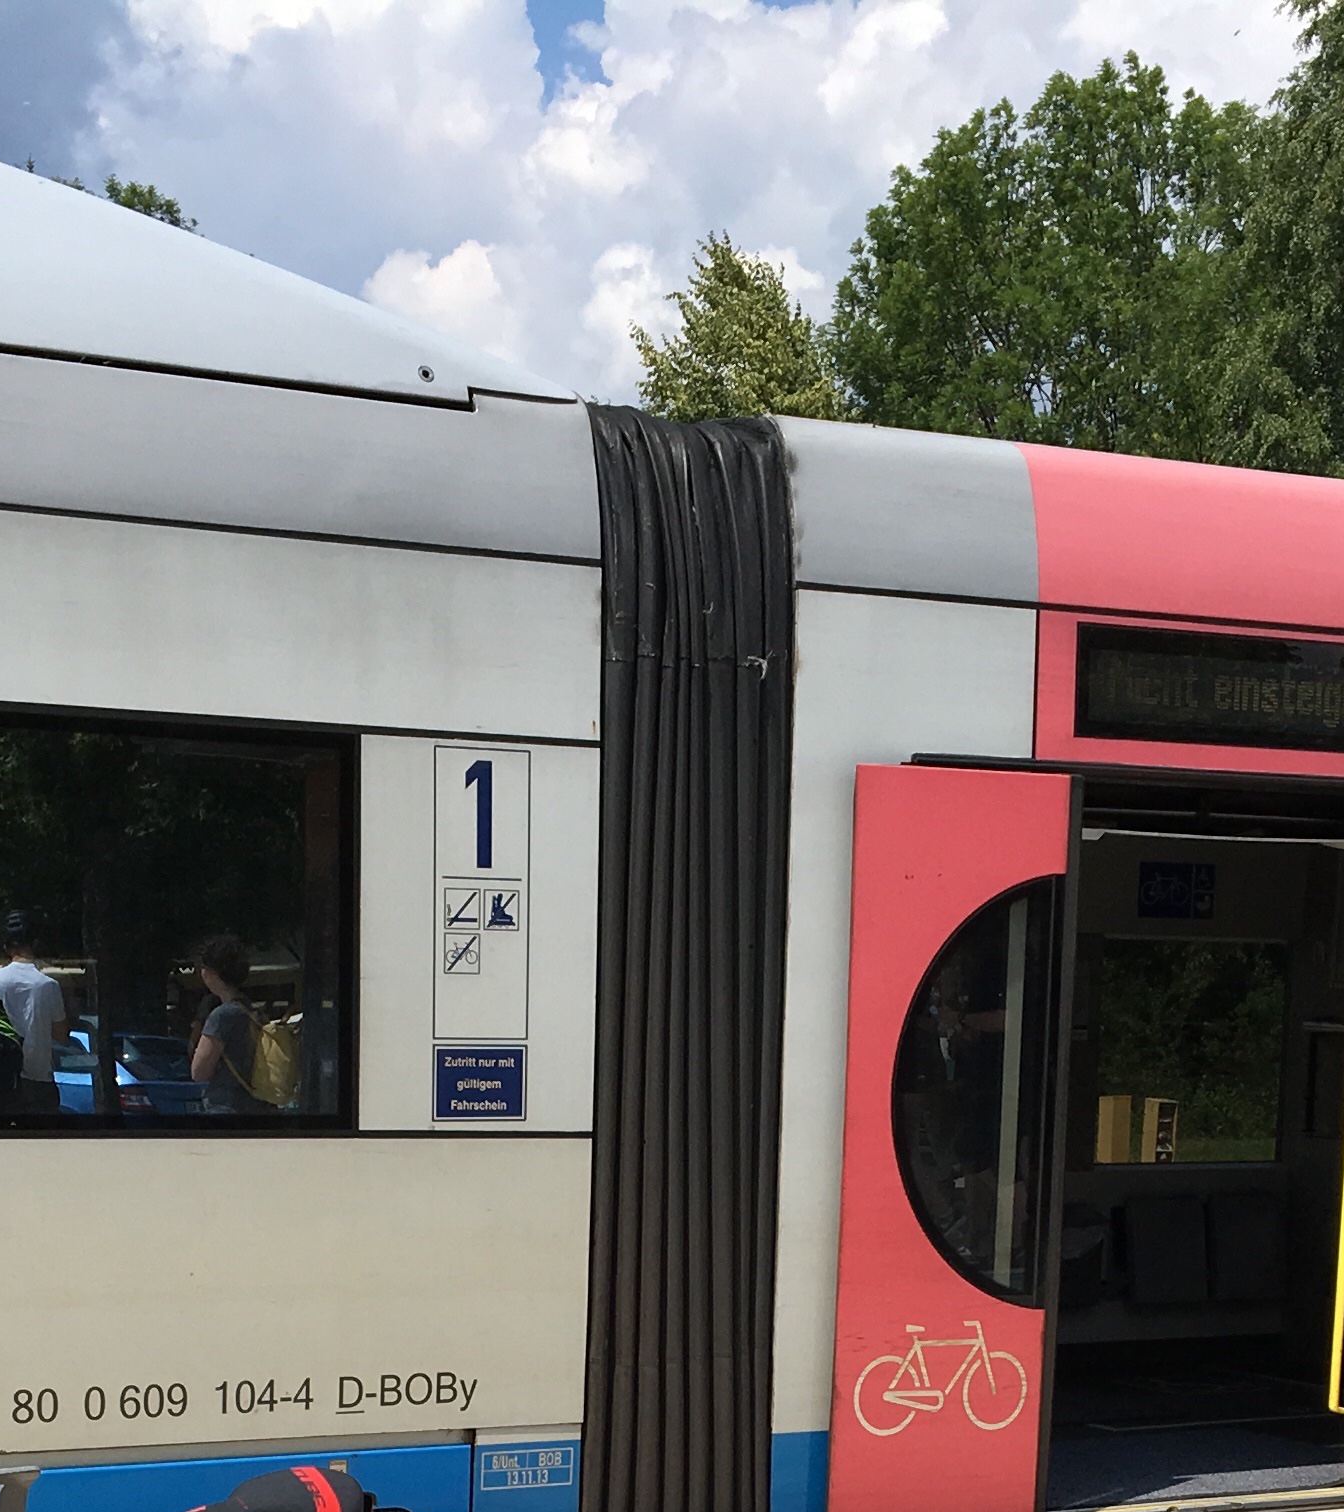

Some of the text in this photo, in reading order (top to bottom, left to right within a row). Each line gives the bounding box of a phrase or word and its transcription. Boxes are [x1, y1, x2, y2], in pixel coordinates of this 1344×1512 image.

[464, 759, 493, 869] 1
[444, 1056, 515, 1069] Zutritt nur mit
[456, 1077, 502, 1092] gültigem
[450, 1099, 508, 1112] Fahrschein
[11, 1388, 60, 1424] 80
[215, 1377, 314, 1415] 104-4
[336, 1371, 478, 1415] D-BOBy
[538, 1451, 562, 1467] BOB
[507, 1469, 549, 1486] 13.11.13
